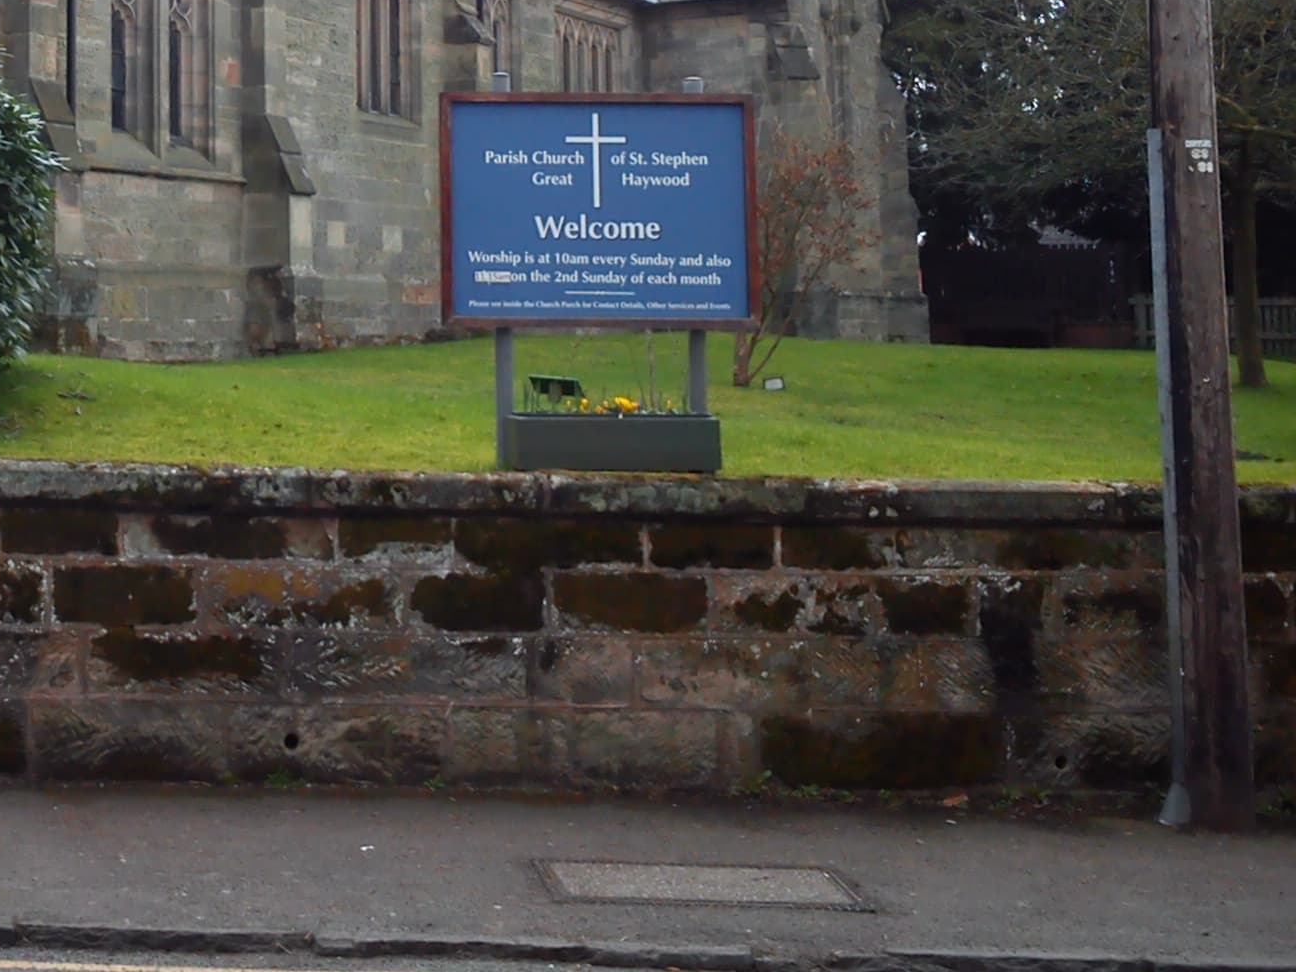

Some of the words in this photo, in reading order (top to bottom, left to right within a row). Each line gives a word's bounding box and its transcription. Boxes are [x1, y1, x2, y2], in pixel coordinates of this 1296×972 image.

[485, 150, 528, 164] Parish
[532, 150, 584, 165] Church
[610, 151, 626, 165] of
[629, 152, 648, 166] St.
[651, 151, 709, 169] Stephen
[532, 172, 573, 186] Great
[622, 172, 690, 190] Haywood
[534, 214, 661, 240] Welcome
[468, 250, 522, 267] Worship
[524, 251, 535, 264] is
[538, 252, 551, 264] at
[555, 253, 589, 265] 10am
[592, 254, 627, 268] every
[630, 253, 677, 269] Sunday
[679, 254, 703, 267] and
[706, 255, 732, 268] also
[511, 272, 527, 283] on
[531, 270, 551, 283] the
[554, 270, 579, 283] 2nd
[582, 271, 628, 286] Sunday
[631, 272, 645, 285] of
[647, 273, 677, 285] each
[680, 273, 722, 285] month
